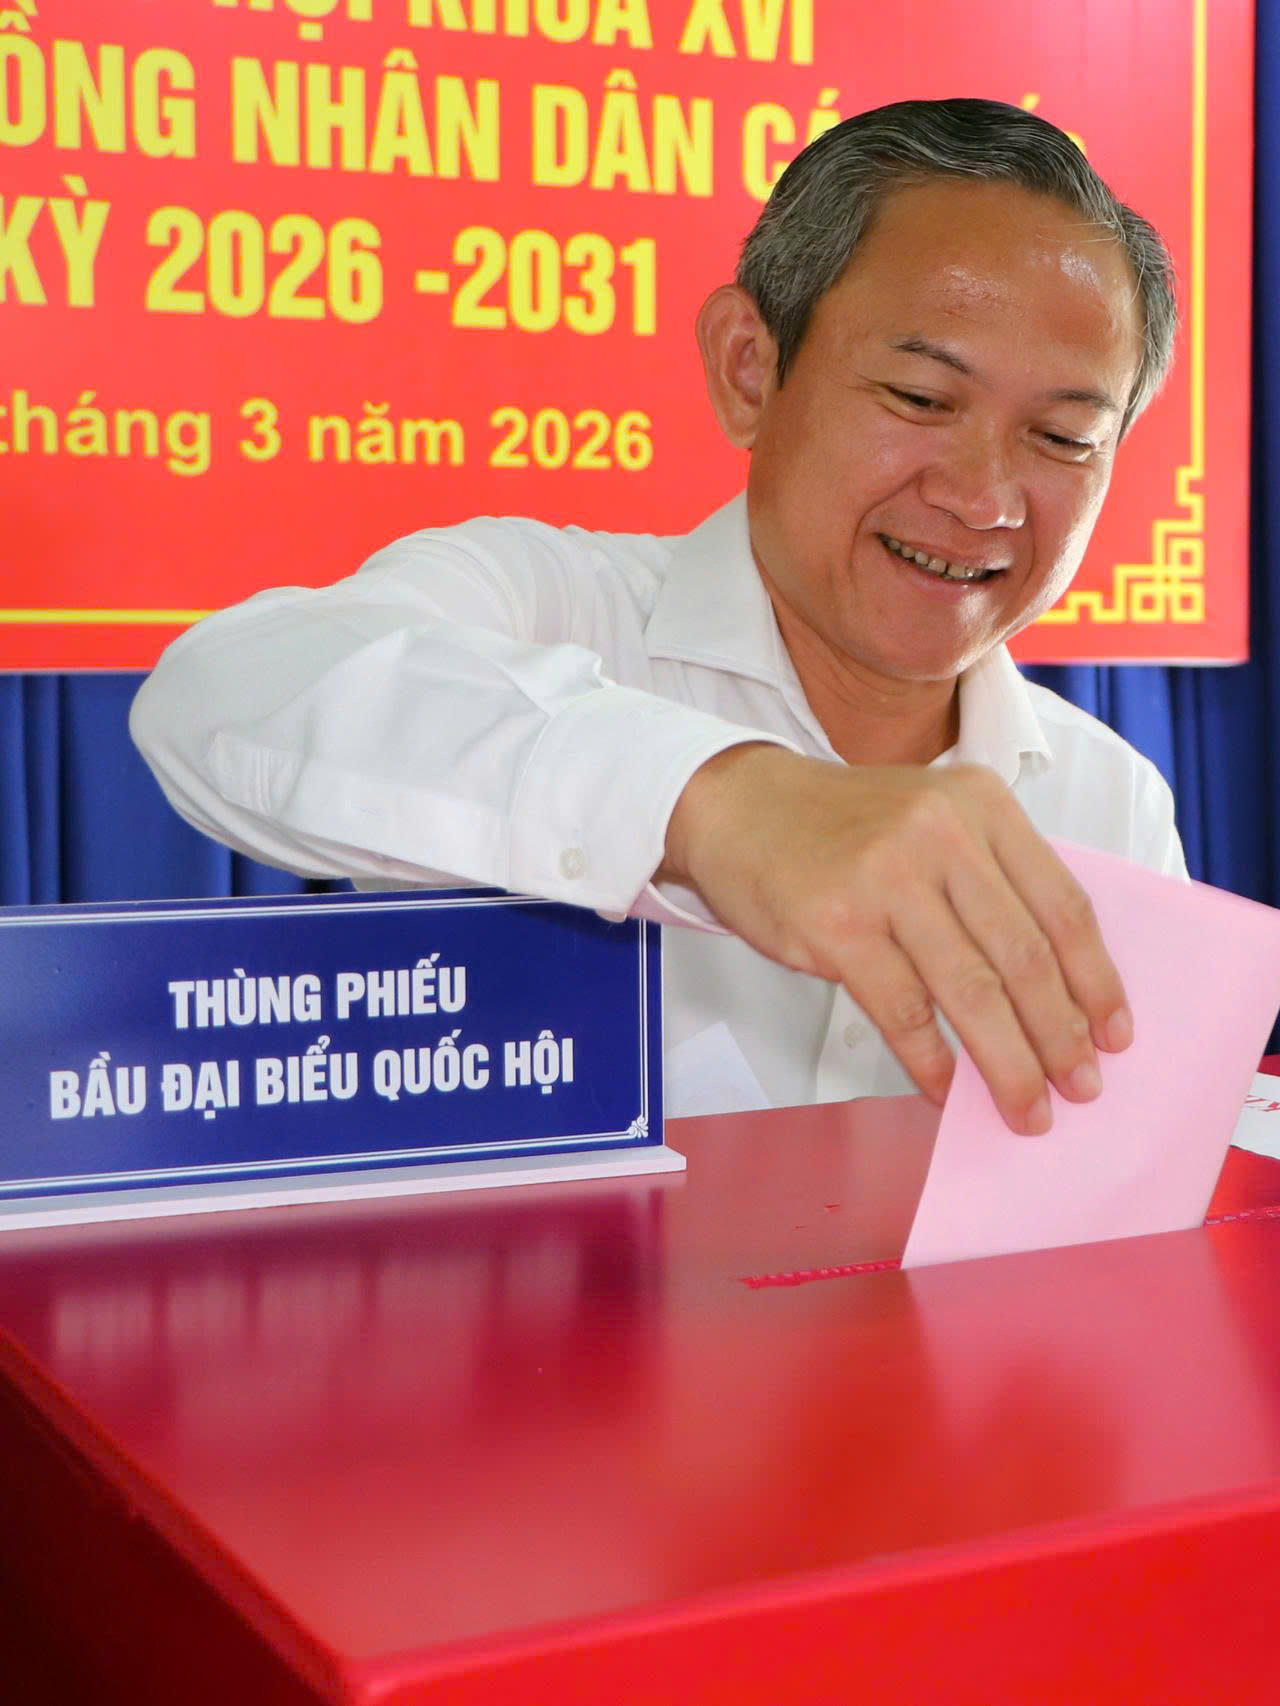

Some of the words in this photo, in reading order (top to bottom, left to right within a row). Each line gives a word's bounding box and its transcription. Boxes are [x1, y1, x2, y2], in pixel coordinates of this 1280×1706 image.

[231, 47, 501, 182] NHÂN
[531, 68, 714, 198] DÂN
[0, 174, 111, 308] KỲ
[145, 205, 384, 324] 2026
[415, 225, 657, 337] -2031
[239, 397, 282, 461] 3
[308, 401, 465, 466] năm
[489, 406, 653, 471] 2026
[168, 967, 322, 1029] THÙNG
[336, 952, 466, 1019] PHIẾU
[49, 1051, 147, 1120] BẦU
[160, 1059, 240, 1120] ĐẠI
[255, 1034, 359, 1105] BIỂU
[373, 1028, 490, 1101] QUỐC
[504, 1029, 574, 1095] HỘI
